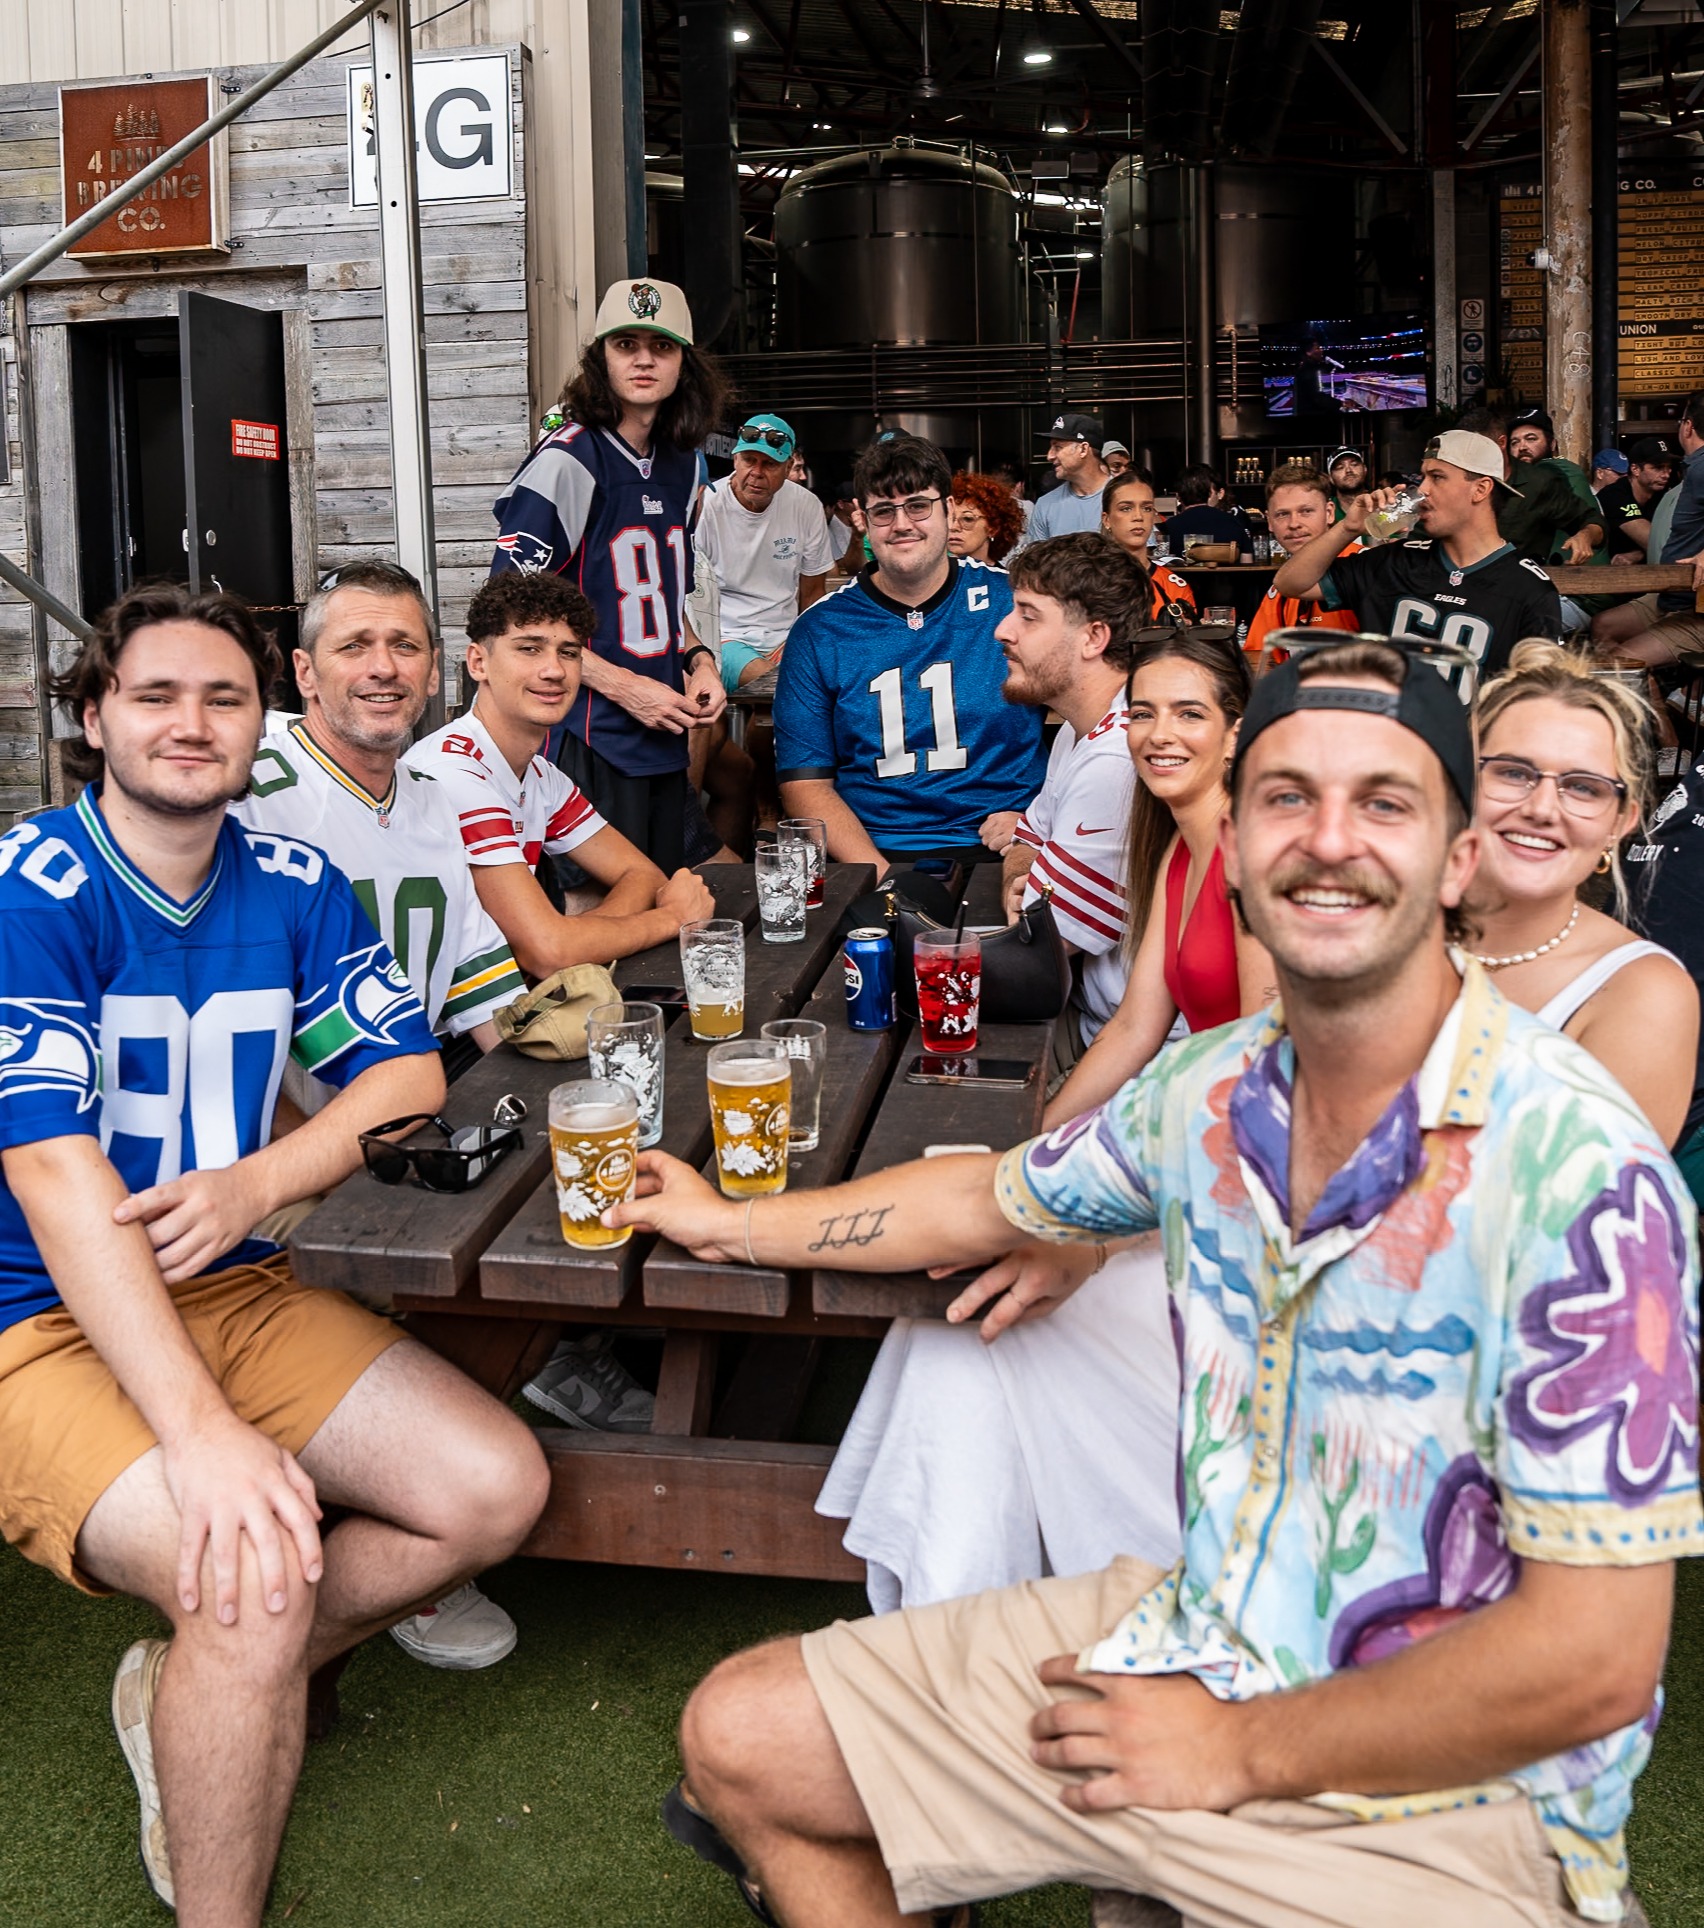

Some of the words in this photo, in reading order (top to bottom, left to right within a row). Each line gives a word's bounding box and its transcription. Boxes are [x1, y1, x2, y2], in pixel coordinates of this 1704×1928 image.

[87, 150, 103, 174] 4
[110, 145, 184, 172] PIN
[77, 174, 203, 205] BRING
[1635, 179, 1657, 190] CO.
[117, 206, 166, 232] CO.
[1635, 312, 1670, 321] SMOOTH
[1620, 324, 1657, 335] UNION
[1636, 341, 1664, 349] TIGHT
[1663, 354, 1681, 362] AND
[1635, 369, 1675, 377] CLASSIC
[609, 525, 686, 659] 81
[967, 585, 990, 612] C
[1434, 593, 1467, 606] EAGLES
[868, 660, 968, 780] 11
[99, 988, 295, 1193] 80
